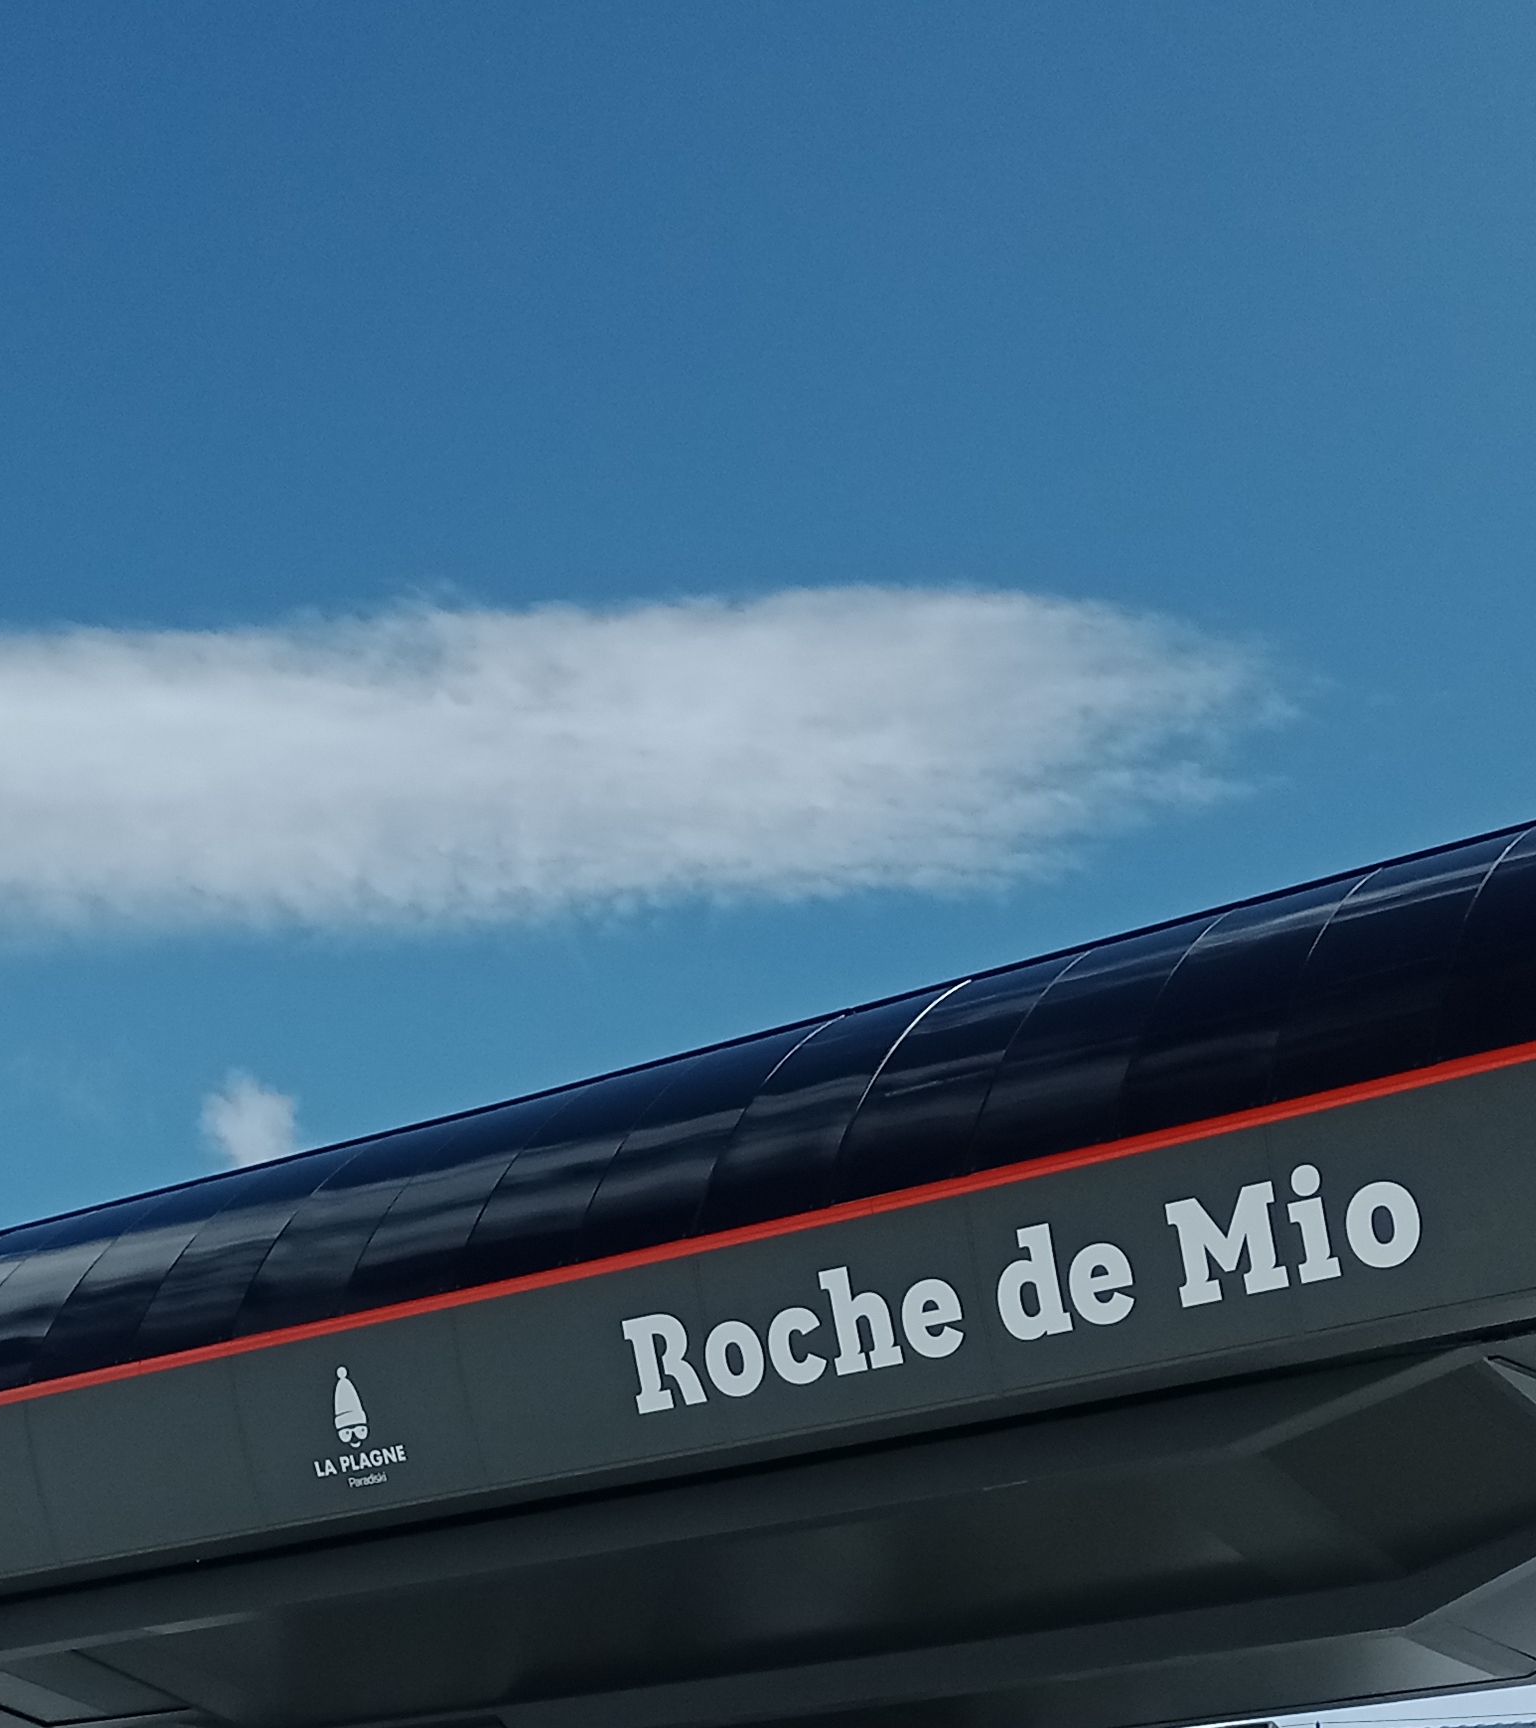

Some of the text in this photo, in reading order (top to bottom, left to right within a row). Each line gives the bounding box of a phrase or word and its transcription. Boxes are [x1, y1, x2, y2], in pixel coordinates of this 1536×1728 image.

[621, 1164, 1422, 1415] Roche de Mio
[313, 1444, 407, 1478] LA PLAGNE
[347, 1471, 388, 1488] Paradiski
